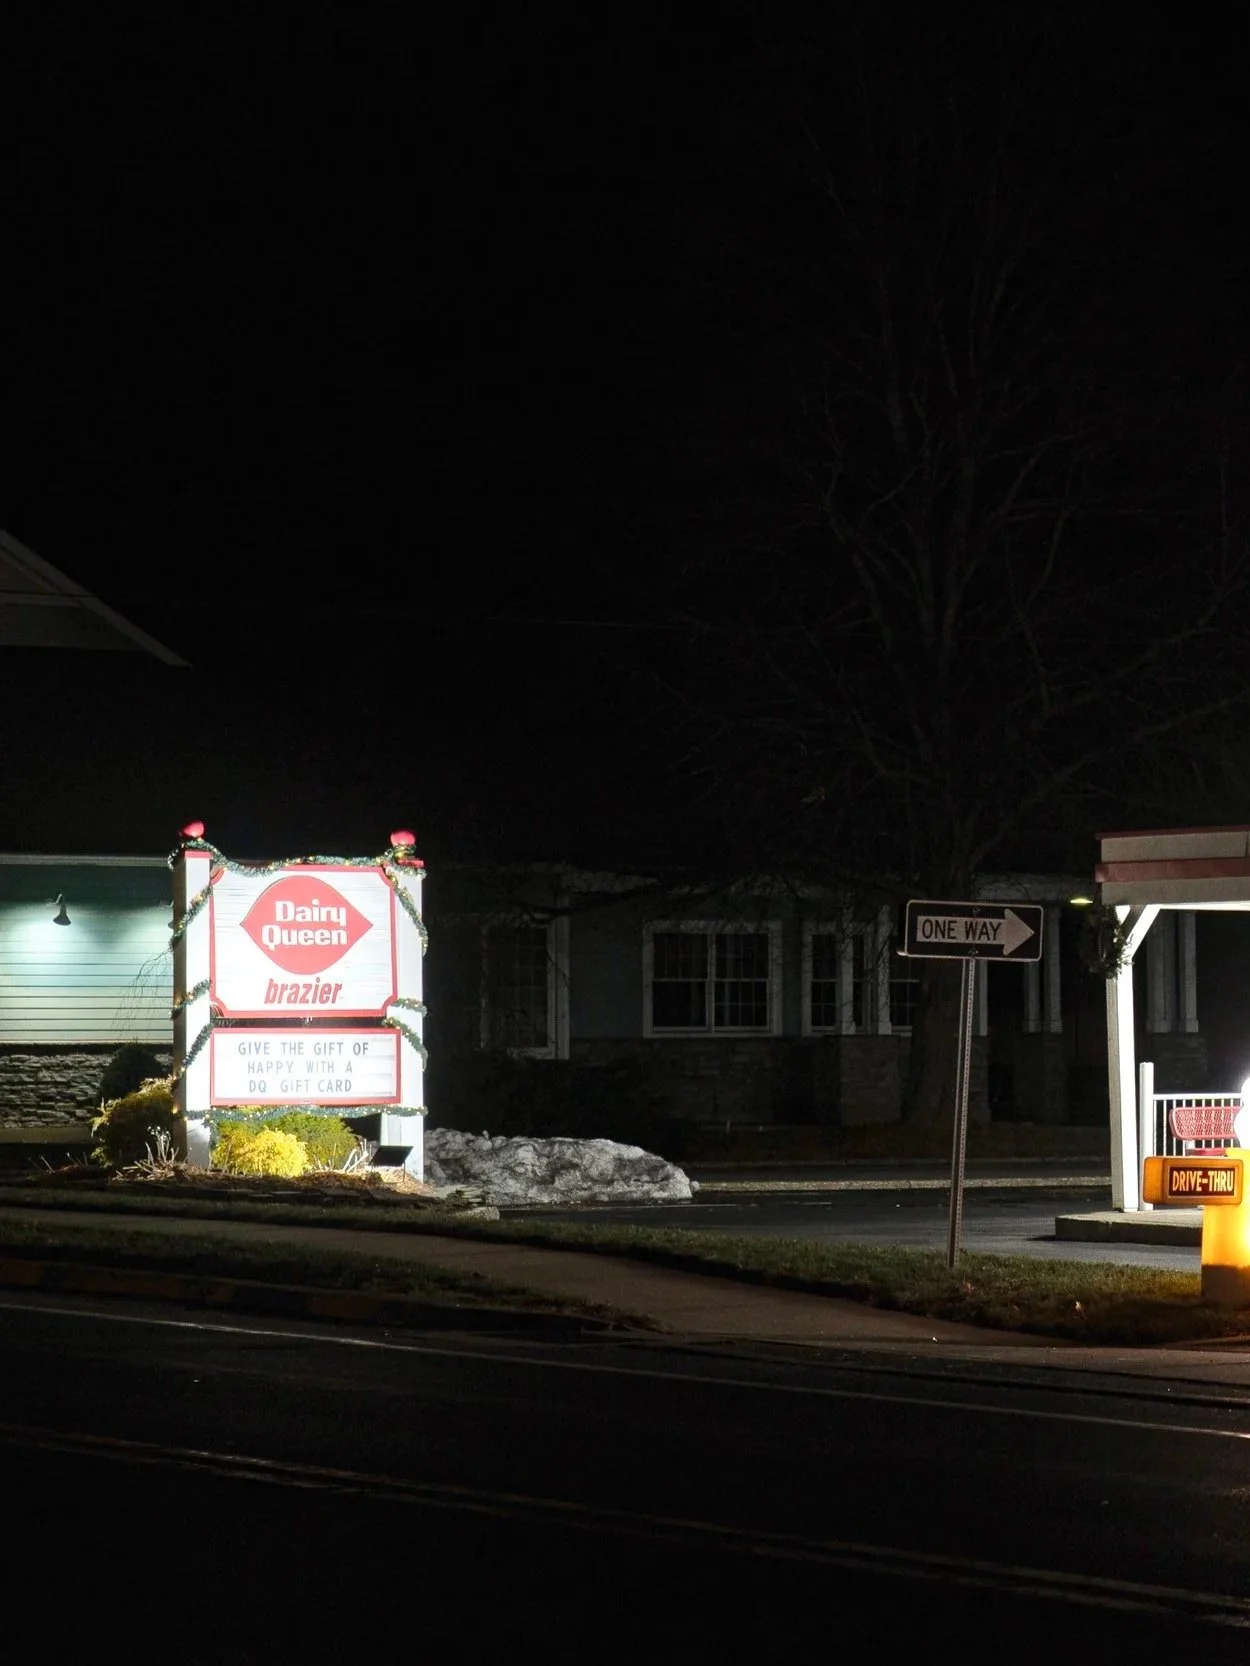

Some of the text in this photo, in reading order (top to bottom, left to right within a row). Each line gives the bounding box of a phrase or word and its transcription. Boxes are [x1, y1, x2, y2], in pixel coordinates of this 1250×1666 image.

[275, 898, 347, 927] Dairy
[261, 924, 348, 952] Queen
[921, 919, 1002, 941] ONE WAY
[264, 976, 343, 1004] brazier
[238, 1042, 369, 1056] GIVE THE GIFT OF
[247, 1060, 353, 1074] HAPPY WITH A
[249, 1080, 352, 1093] DQ GIFT CARD
[1172, 1170, 1234, 1192] DRIVE-THRU
